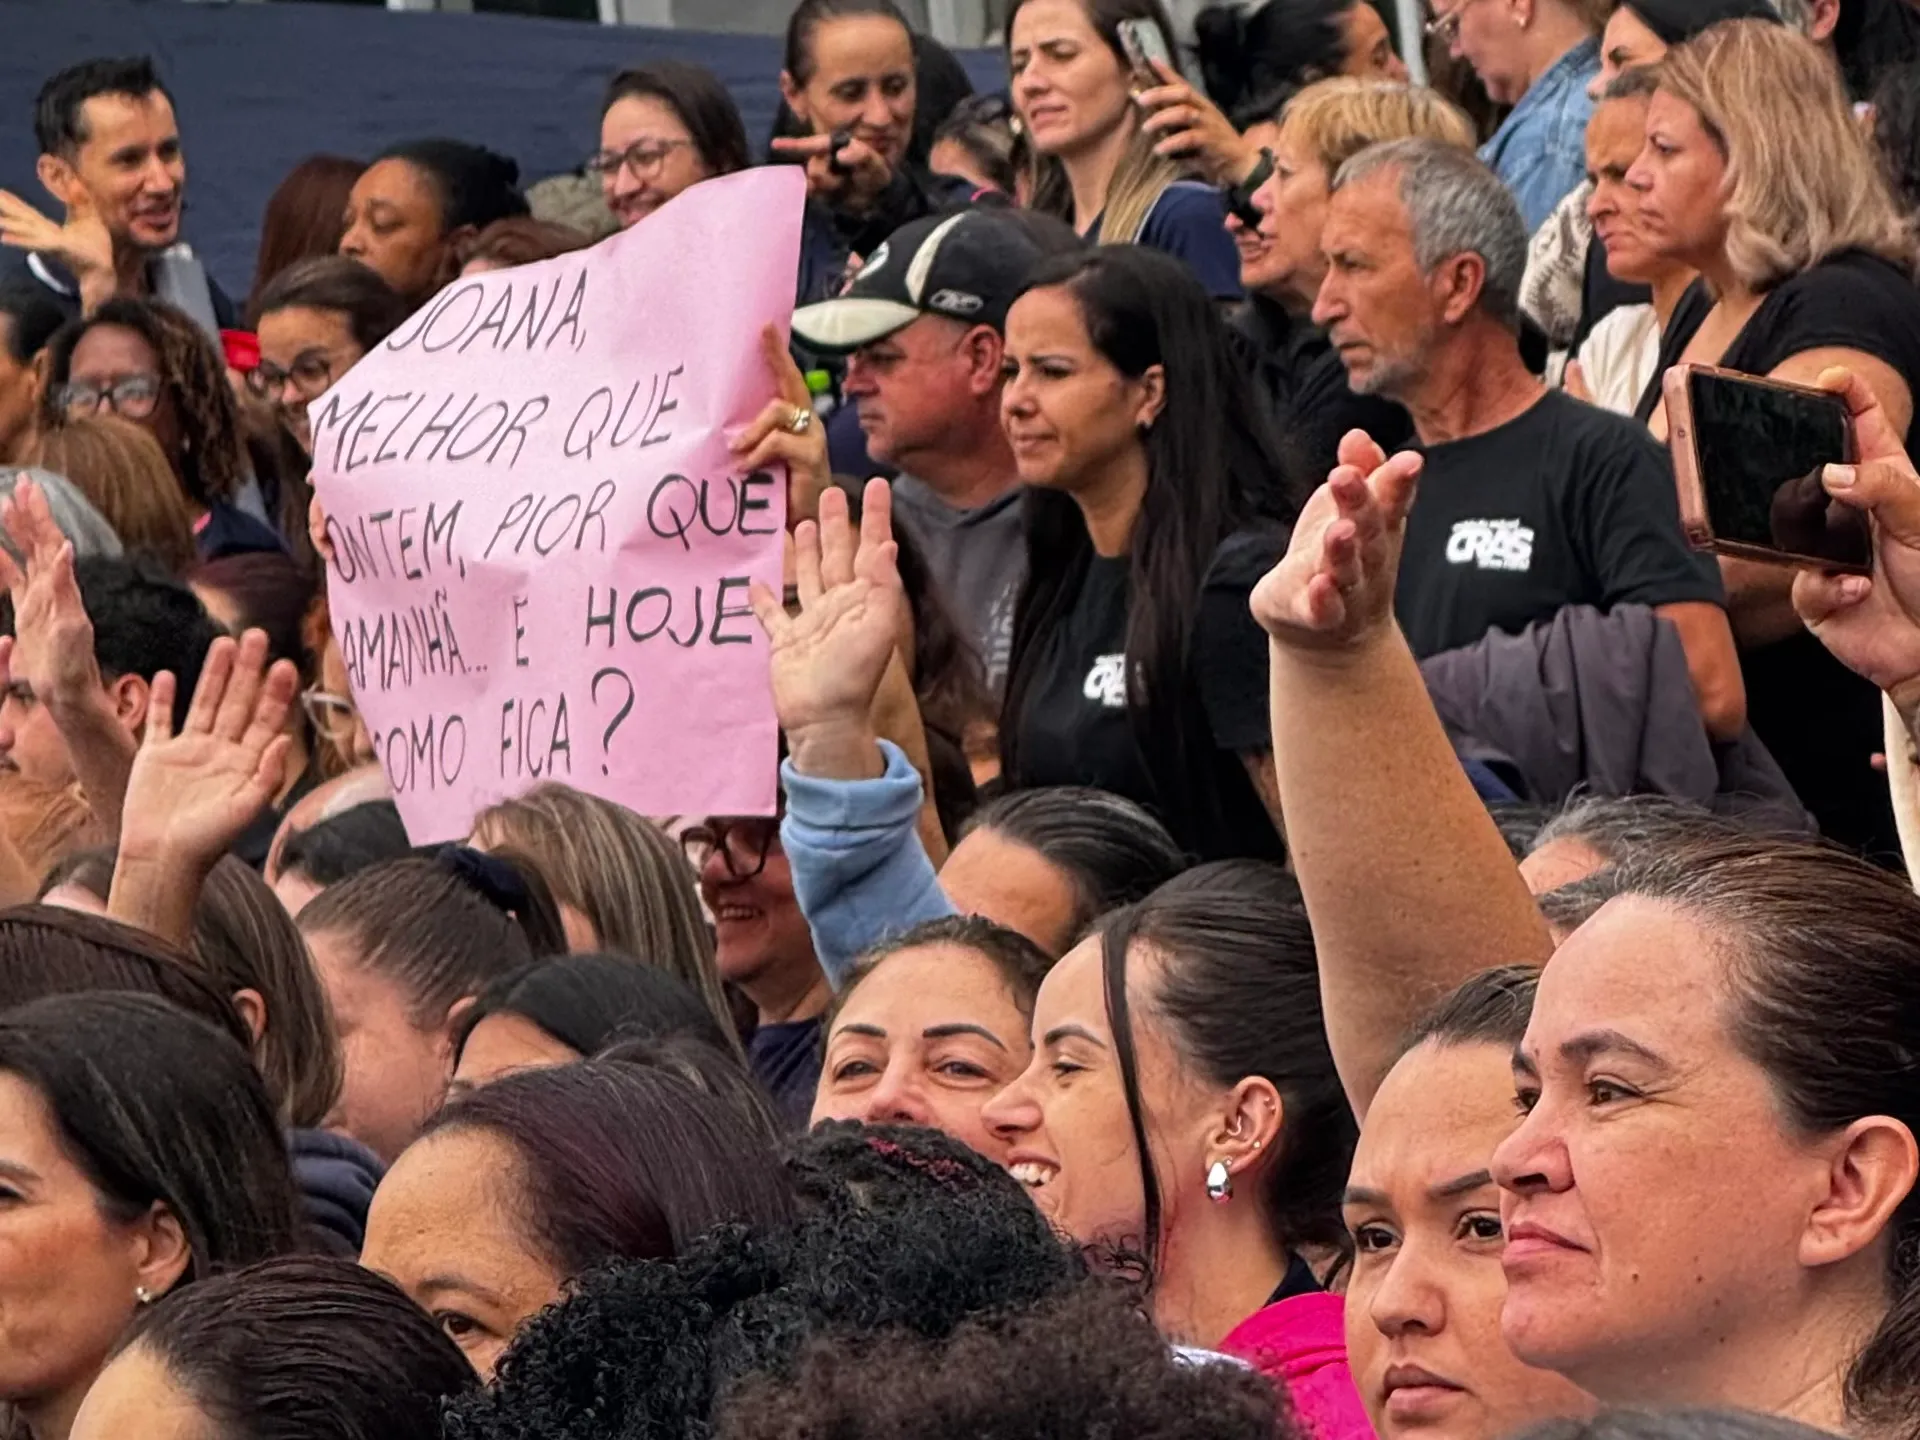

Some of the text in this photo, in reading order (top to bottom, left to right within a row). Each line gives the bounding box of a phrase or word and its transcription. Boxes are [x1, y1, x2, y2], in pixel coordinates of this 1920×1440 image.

[386, 268, 589, 354] JOANA,
[312, 361, 684, 474] MELHOR QUE
[325, 472, 777, 582] ONTEM, PIOR QUE
[511, 595, 530, 668] E
[585, 575, 754, 648] HOJE
[500, 692, 571, 778] FICA
[590, 666, 635, 776] ?
